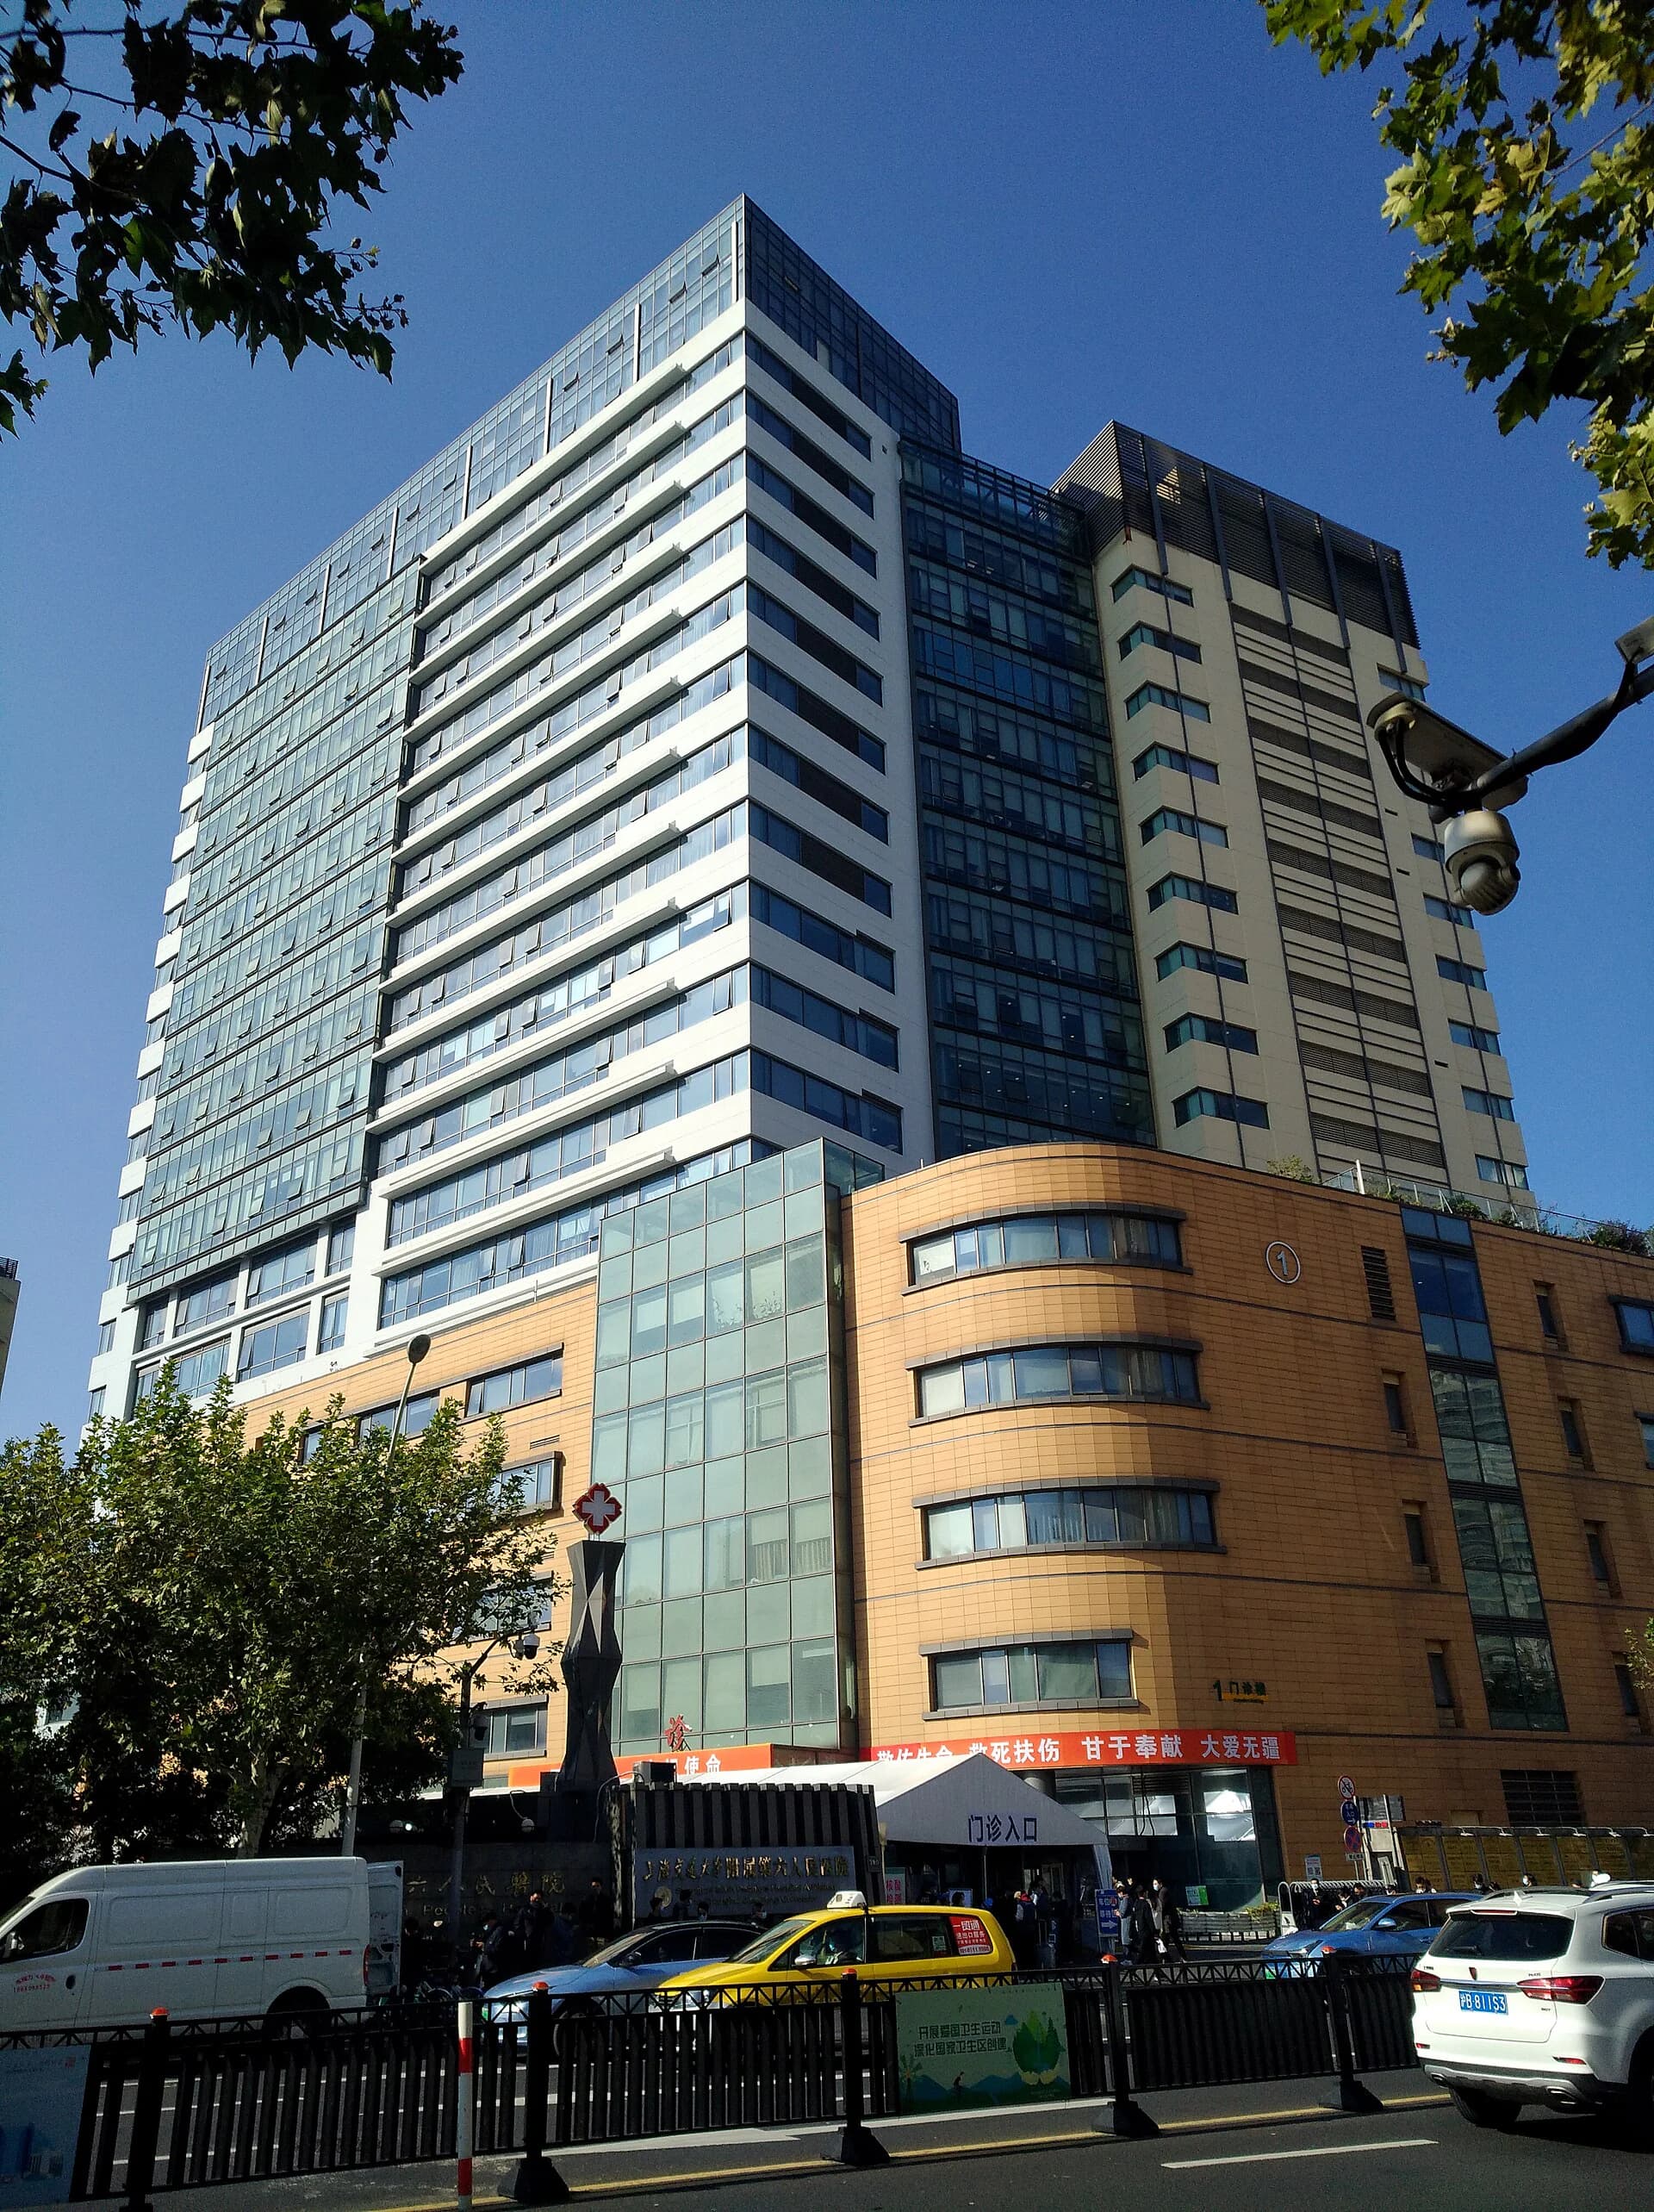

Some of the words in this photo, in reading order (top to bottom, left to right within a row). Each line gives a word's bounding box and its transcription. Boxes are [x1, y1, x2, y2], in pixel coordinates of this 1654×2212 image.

[1277, 1252, 1288, 1276] 1
[1082, 1735, 1182, 1760] 甘于奉献
[1200, 1734, 1279, 1760] 大爱无疆
[967, 1814, 1039, 1842] 门诊入口
[918, 2020, 1002, 2040] 开展爱国卫生运动
[913, 2037, 1009, 2058] 深化国家卫生区创建
